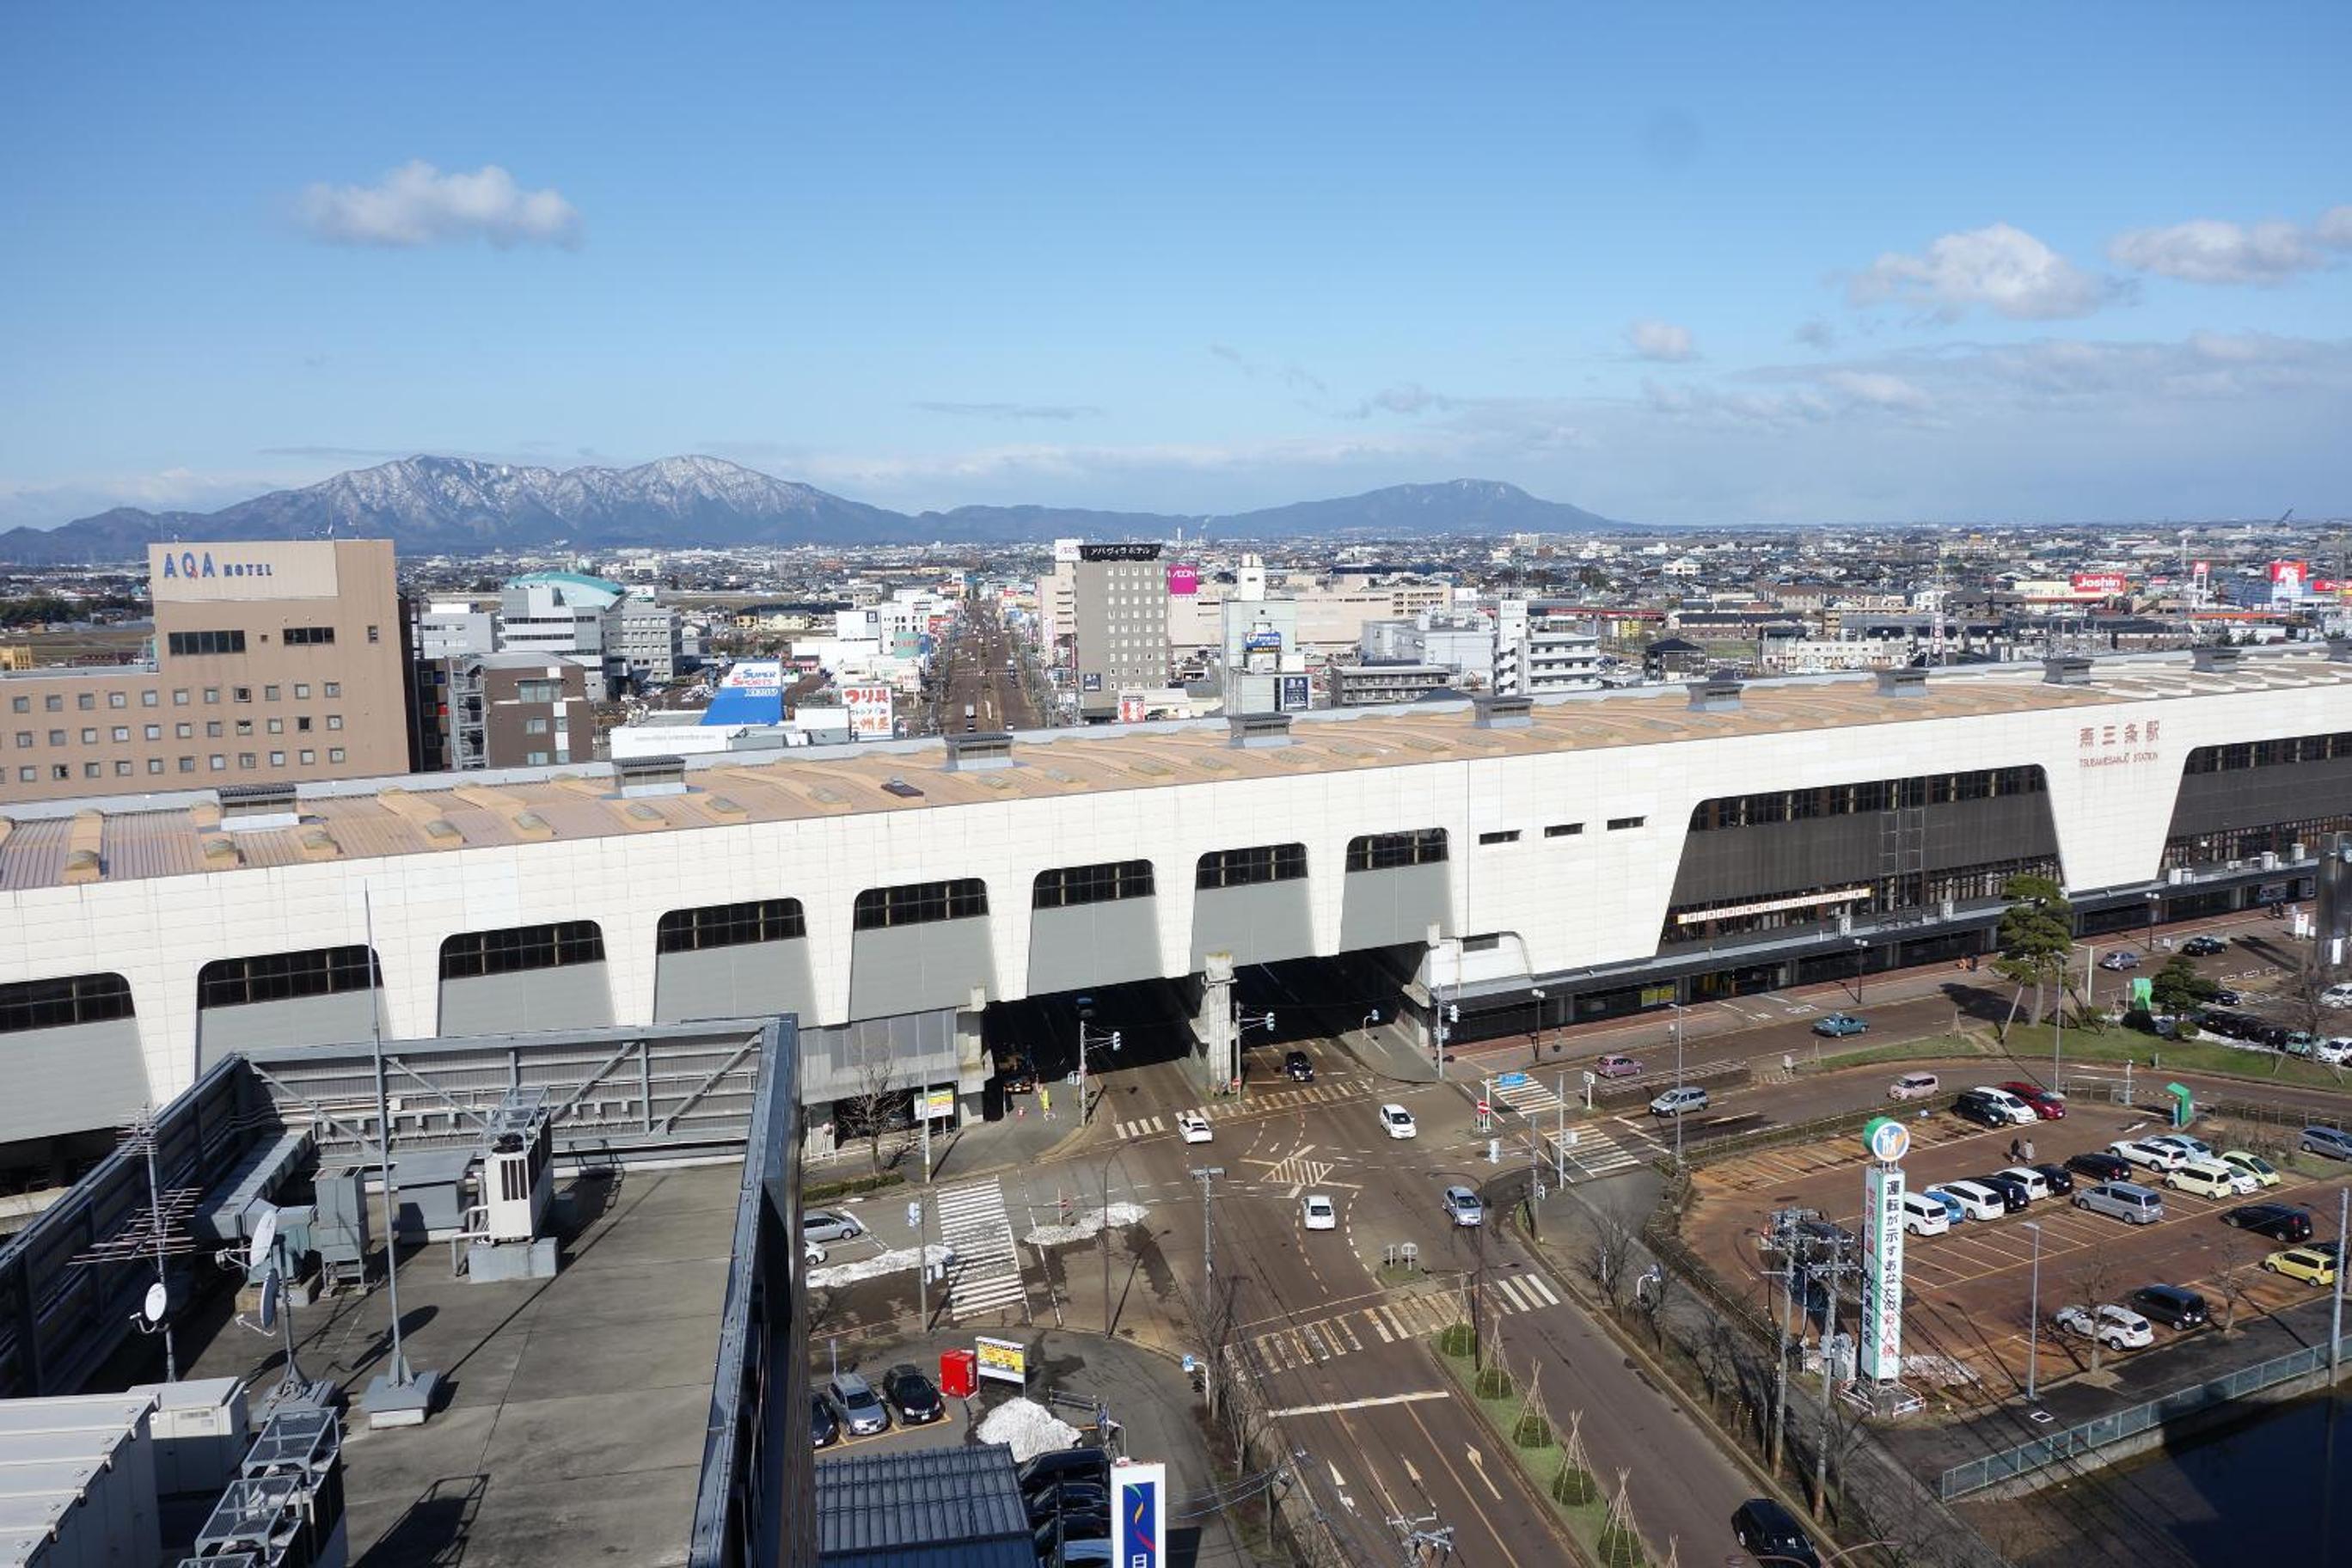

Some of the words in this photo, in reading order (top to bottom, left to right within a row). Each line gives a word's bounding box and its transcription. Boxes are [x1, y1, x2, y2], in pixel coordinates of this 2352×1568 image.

[224, 563, 273, 577] HOTEL
[2079, 577, 2121, 588] Joshin
[844, 689, 889, 704] つり具
[2079, 720, 2159, 748] 燕三条駅
